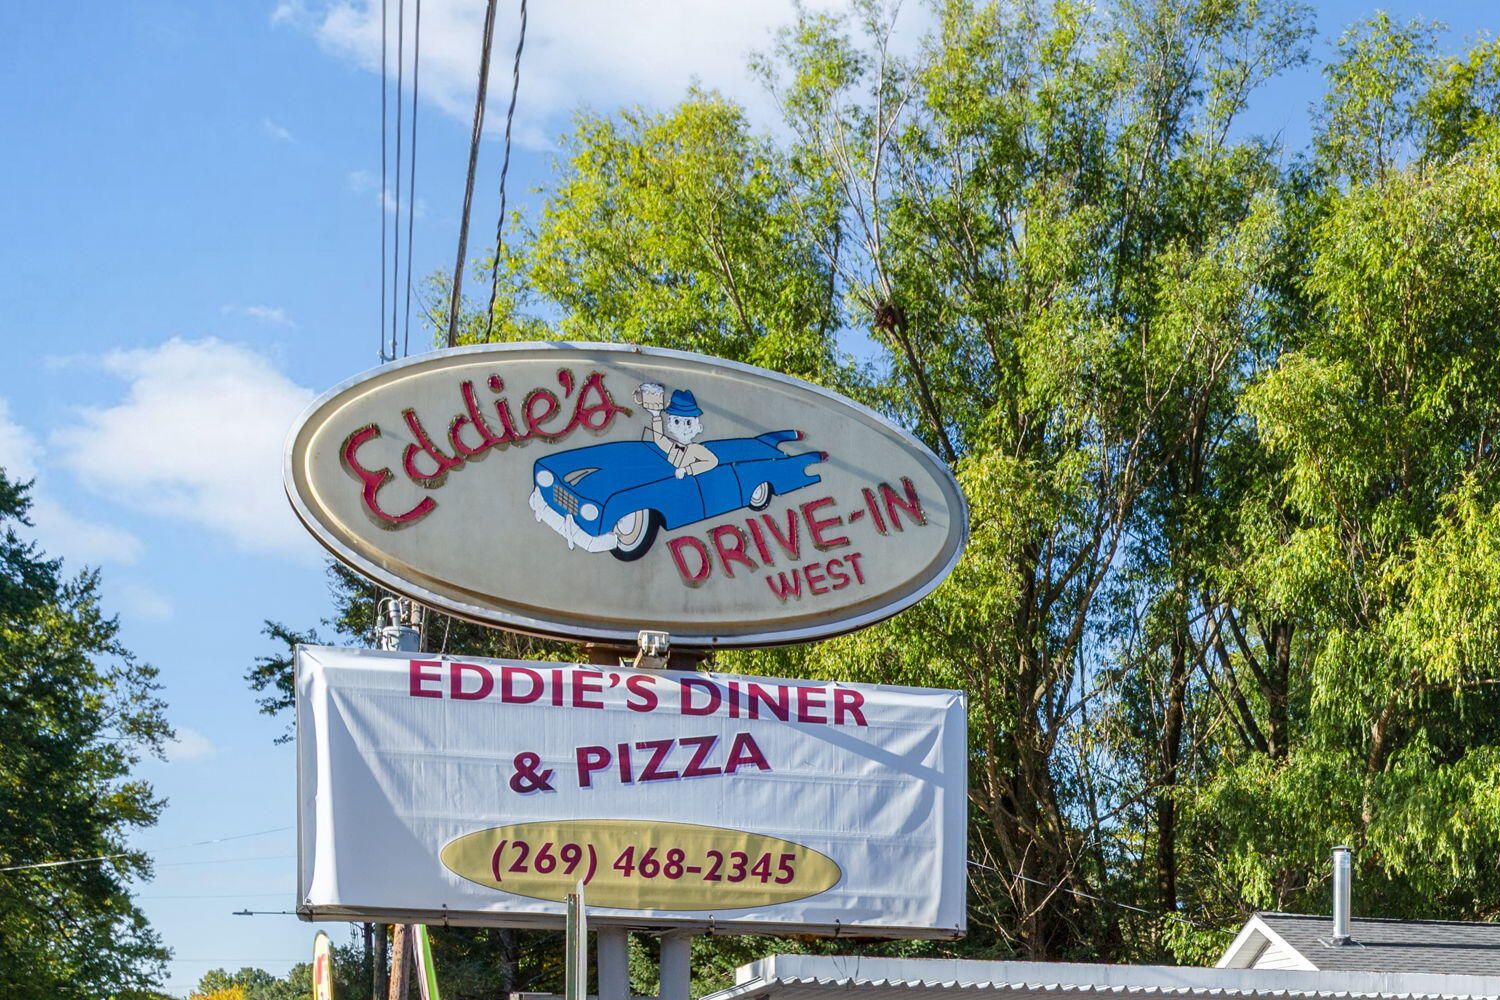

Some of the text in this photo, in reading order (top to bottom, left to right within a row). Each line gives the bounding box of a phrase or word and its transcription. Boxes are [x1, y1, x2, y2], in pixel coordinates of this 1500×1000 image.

[340, 367, 633, 530] Eddie's
[666, 476, 928, 588] DRIVE-IN
[766, 552, 865, 604] WEST
[408, 660, 868, 726] EDDIE'S DINER
[509, 732, 771, 794] & PIZZA
[491, 839, 796, 885] (269) 468-2345
